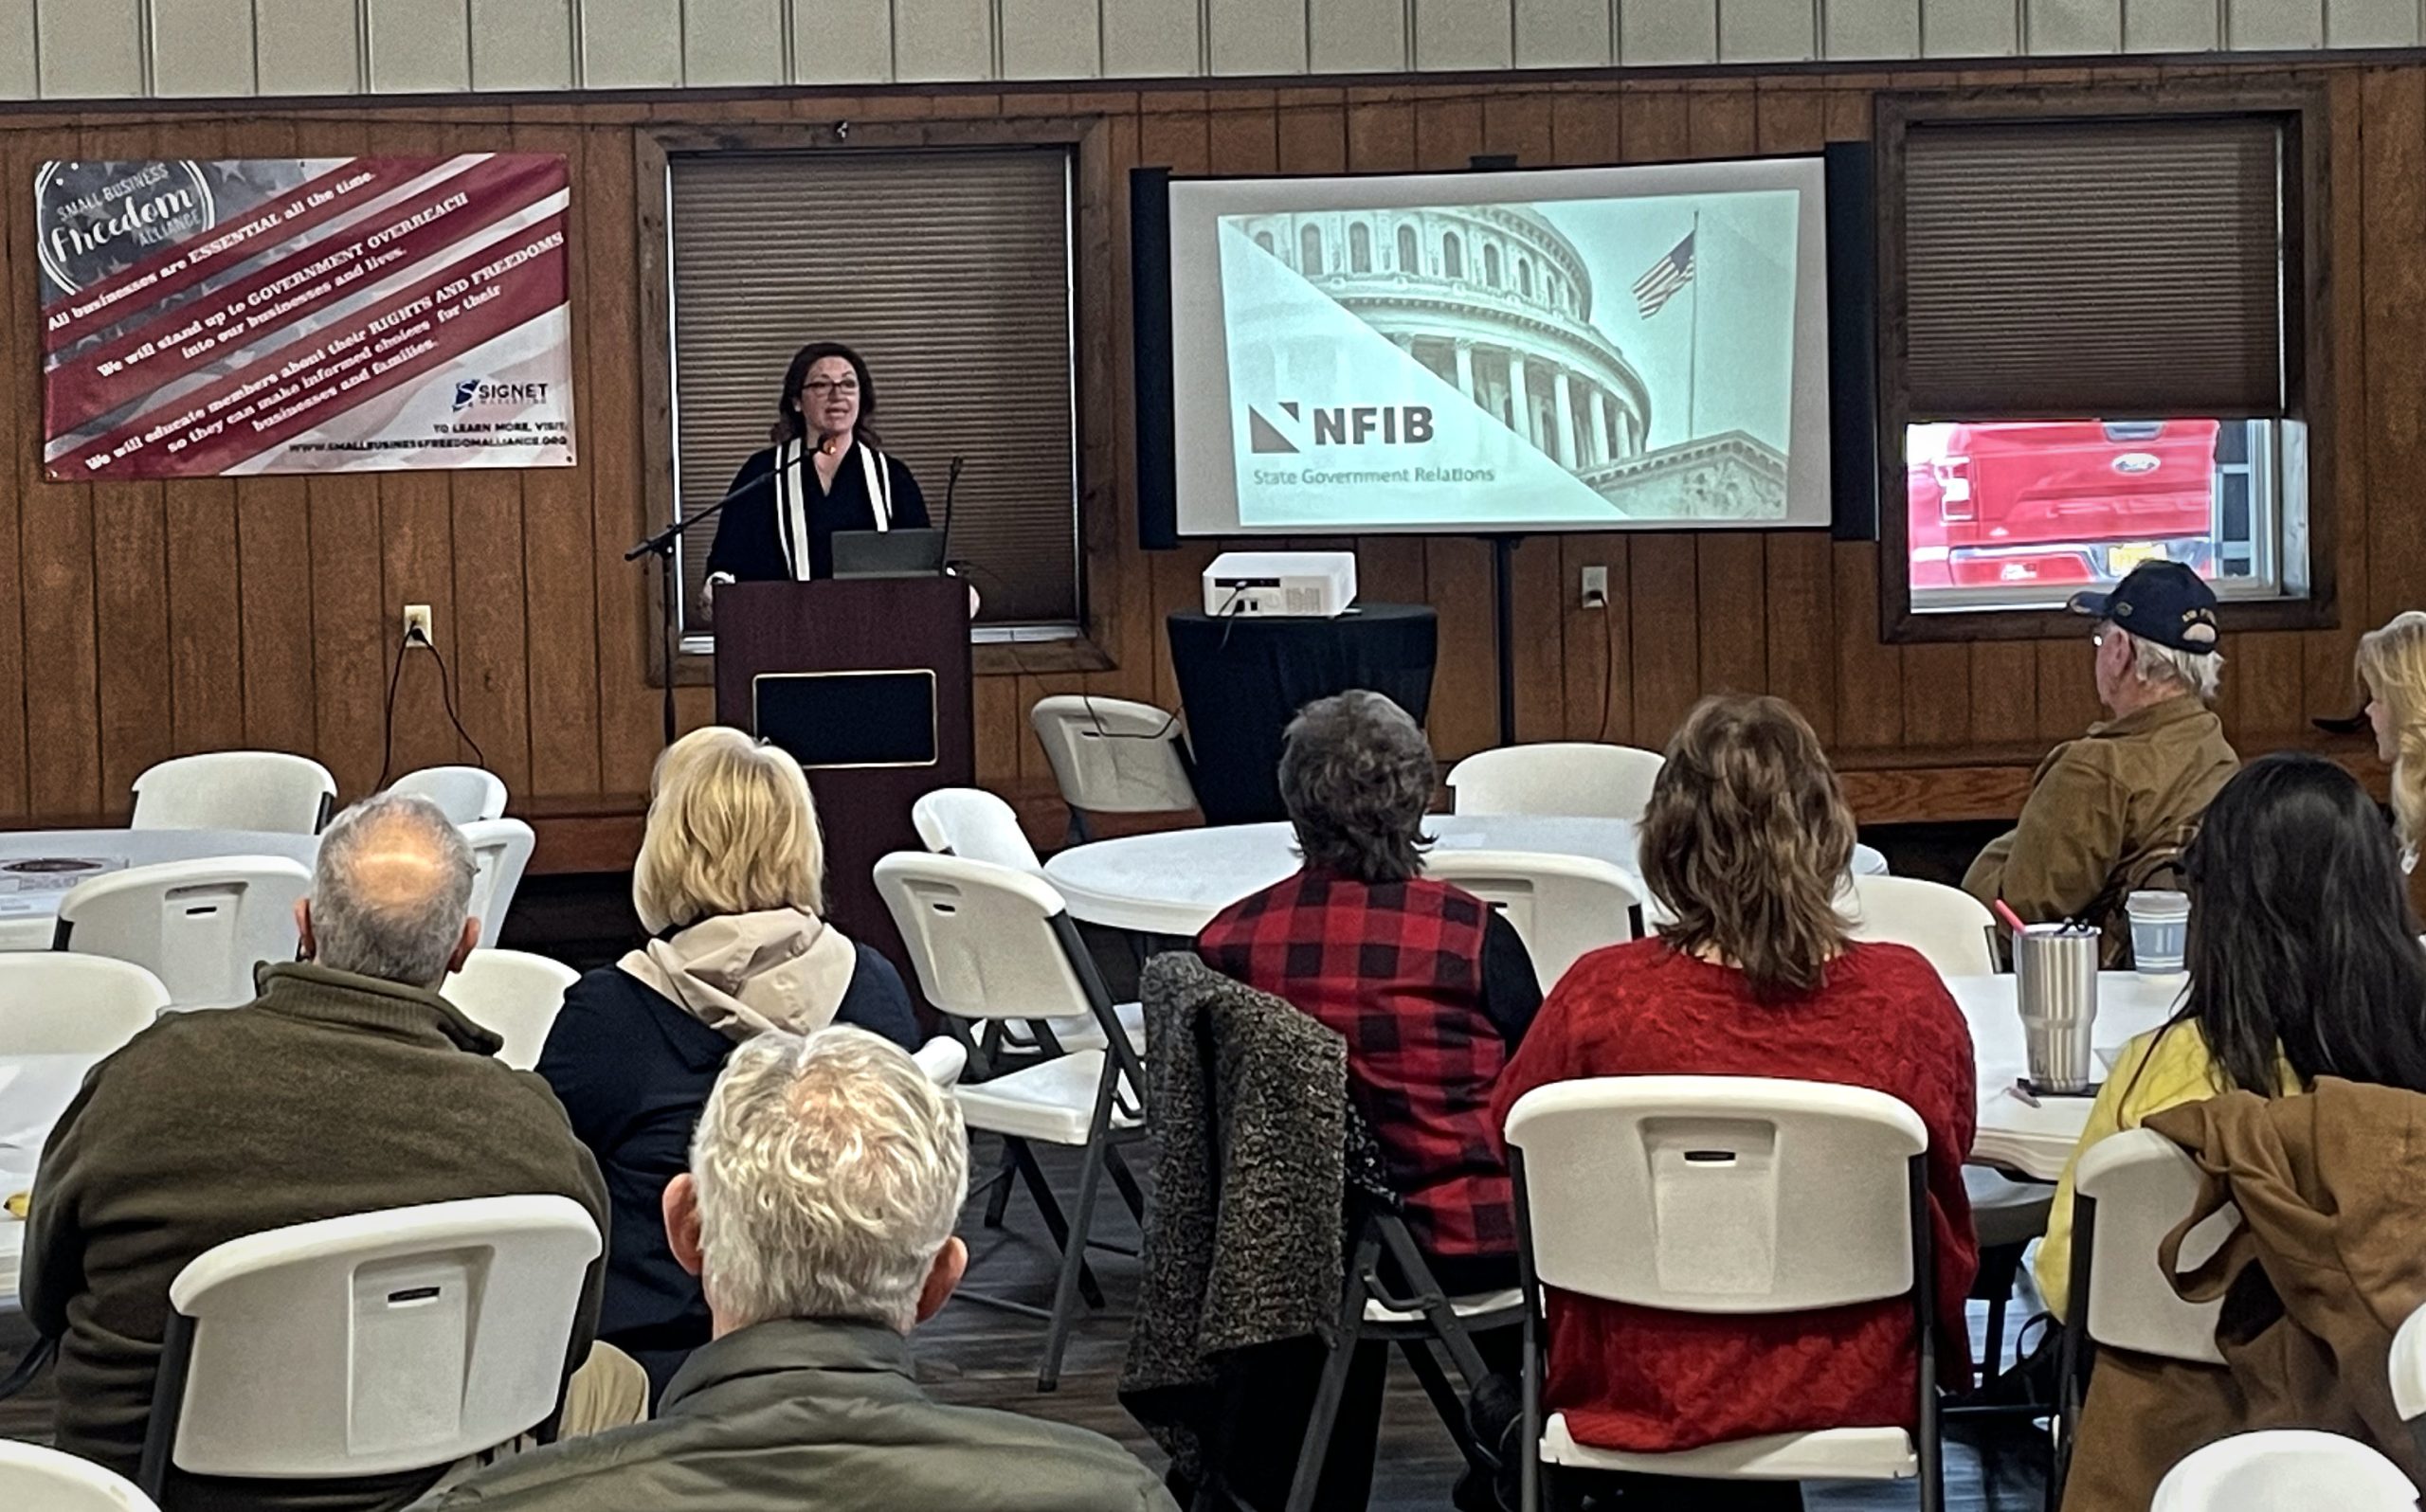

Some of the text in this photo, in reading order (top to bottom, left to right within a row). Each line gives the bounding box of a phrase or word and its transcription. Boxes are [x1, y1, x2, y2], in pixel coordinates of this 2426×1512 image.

[51, 189, 193, 262] Freedom
[57, 163, 170, 222] SMALL BUSINESS
[138, 208, 202, 246] ALLIANCE
[48, 171, 376, 331] All businesses are ESSENTIAL all the time.
[97, 191, 469, 376] We will stand up to GOVERNMENT OVERREACH
[182, 246, 407, 360] into our businesses and lives.
[85, 231, 565, 471] We will educate members about their RIGHTS AND FREEDOMS
[168, 283, 502, 454] so they can make informed choices for their
[251, 337, 439, 432] businesses and families.
[479, 383, 549, 399] SIGNET
[1313, 406, 1434, 445] NFIB
[433, 424, 449, 434] TO
[453, 423, 491, 433] LEARN
[1254, 466, 1495, 485] State Government Relations
